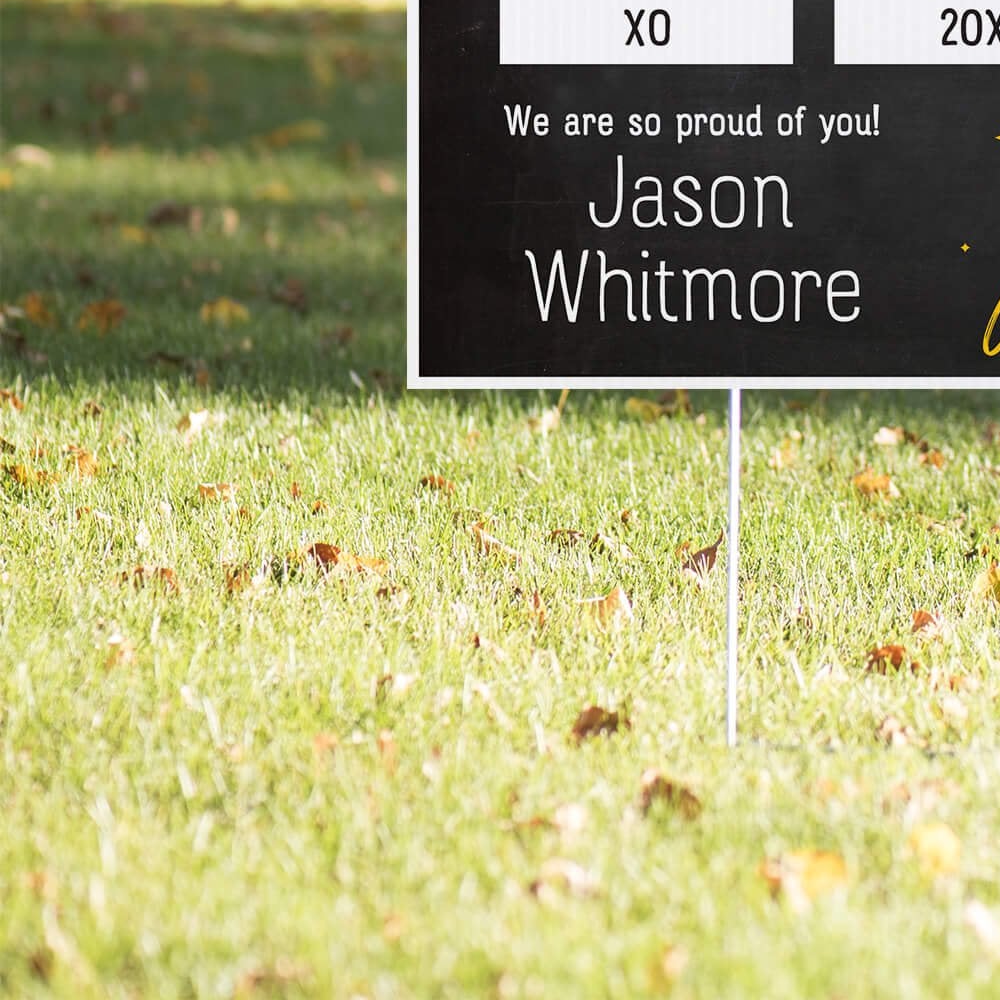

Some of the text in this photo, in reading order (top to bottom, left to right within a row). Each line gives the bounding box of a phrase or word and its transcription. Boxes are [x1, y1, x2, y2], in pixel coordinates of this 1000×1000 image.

[623, 8, 671, 48] XO
[503, 103, 881, 145] We are so proud of you!
[588, 154, 794, 229] Jason
[524, 248, 862, 324] Whitmore
